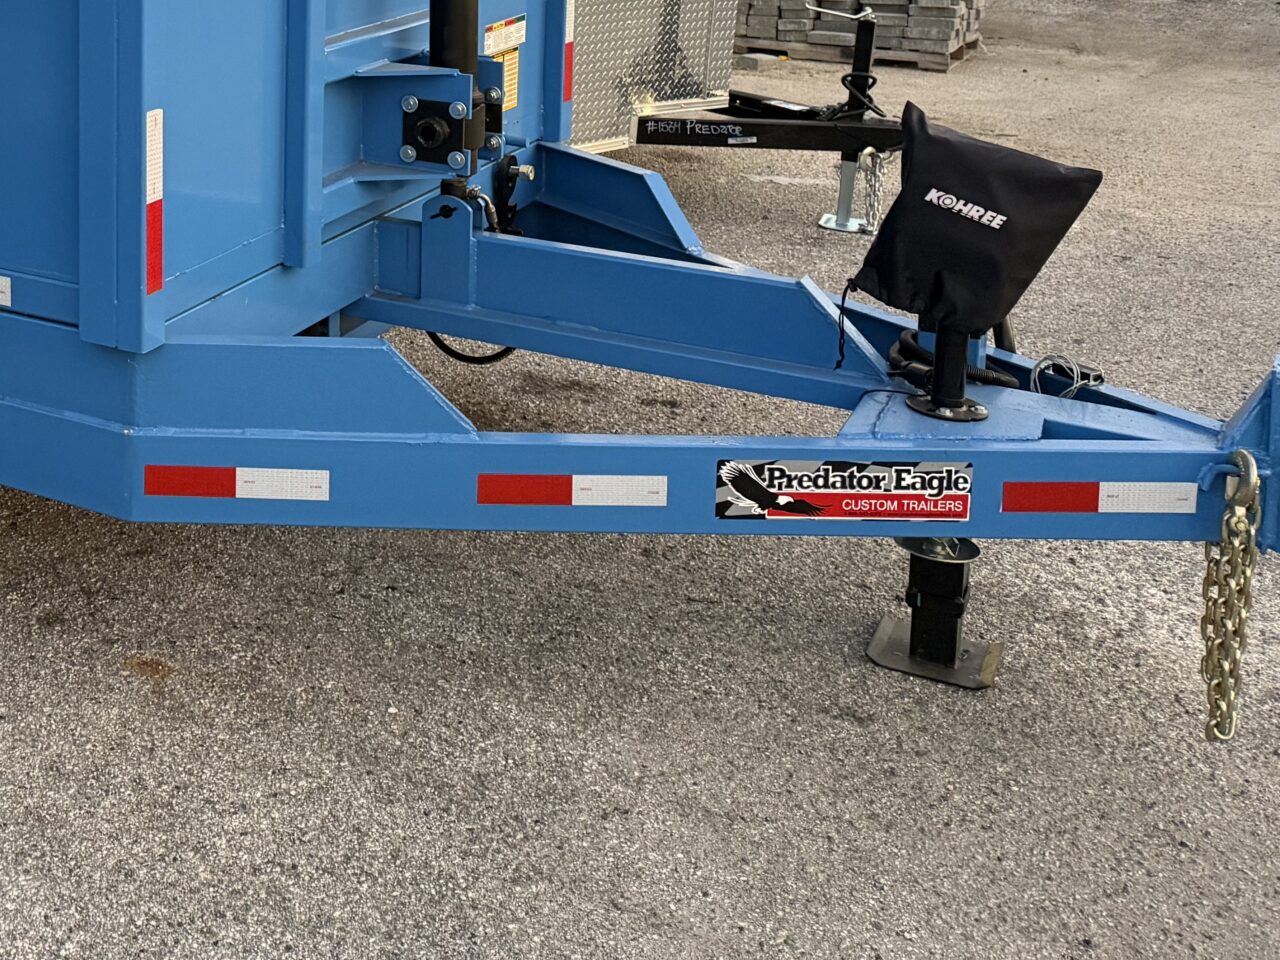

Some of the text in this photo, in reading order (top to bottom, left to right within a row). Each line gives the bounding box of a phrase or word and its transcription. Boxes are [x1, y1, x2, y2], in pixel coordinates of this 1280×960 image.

[924, 188, 1007, 230] KOHREE
[766, 466, 969, 498] Predator Eagle
[842, 499, 963, 512] CUSTOM TRAILERS
